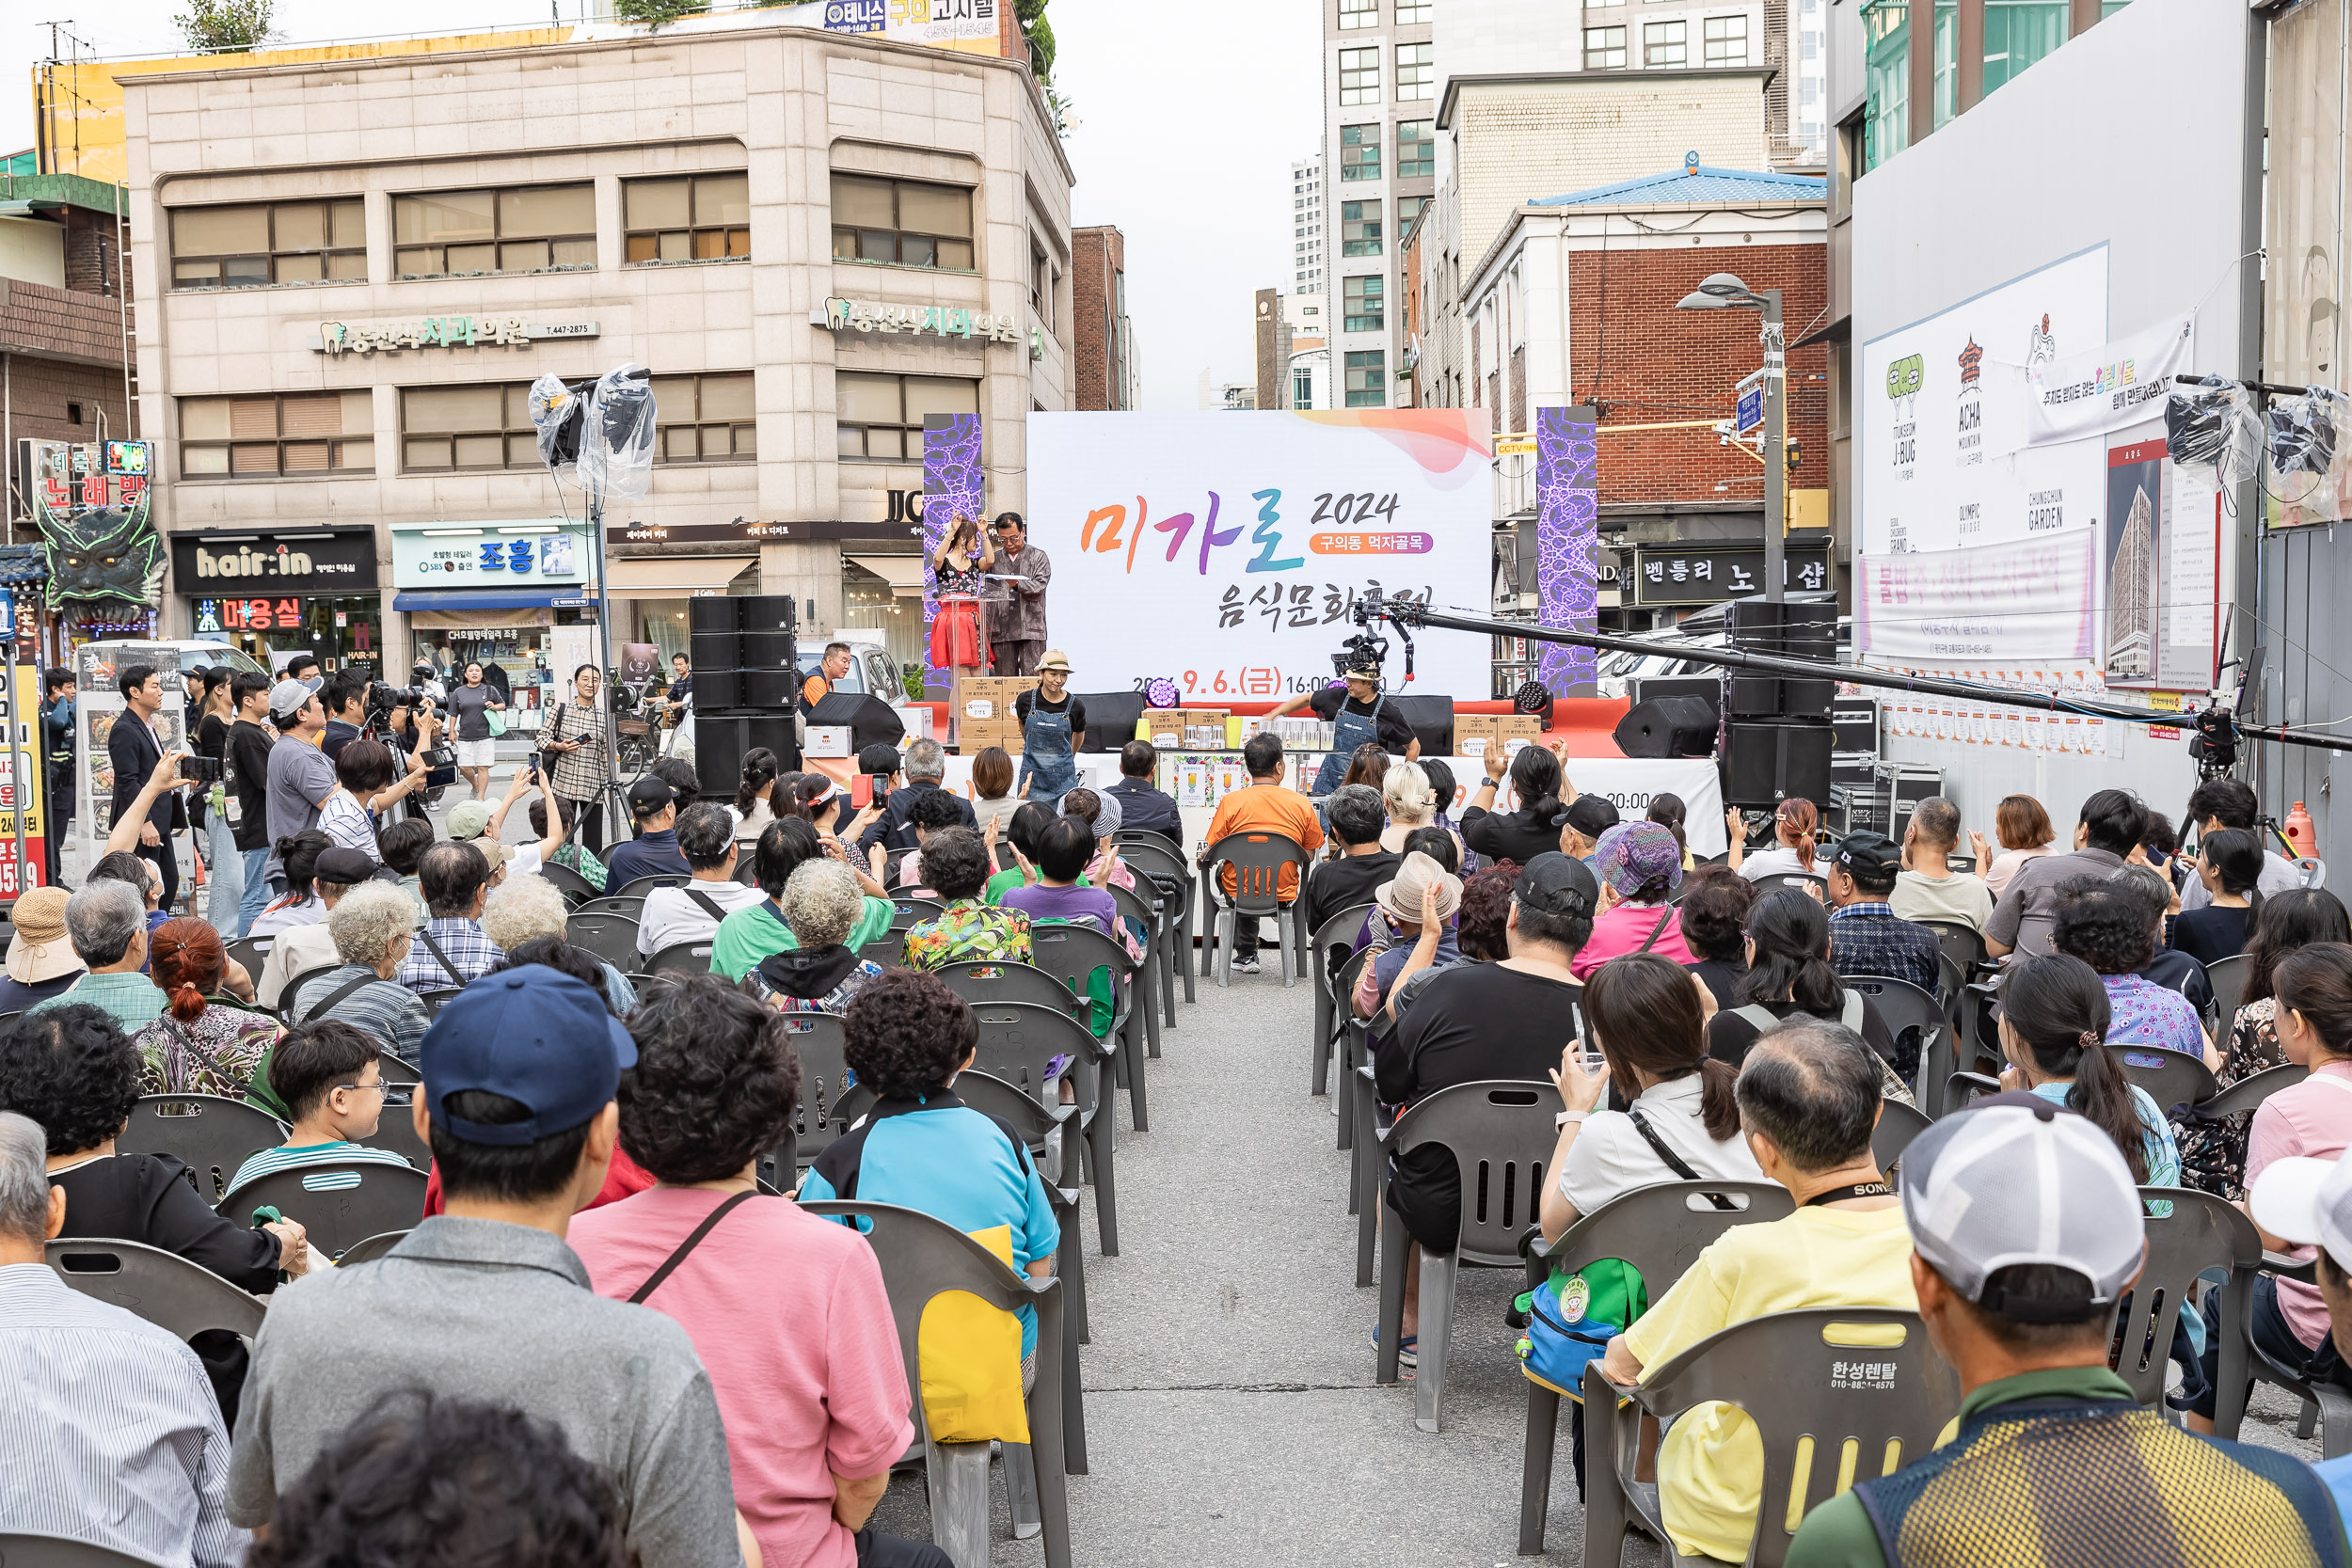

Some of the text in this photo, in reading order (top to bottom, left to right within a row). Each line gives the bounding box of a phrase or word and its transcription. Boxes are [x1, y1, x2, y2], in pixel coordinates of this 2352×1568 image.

[924, 22, 994, 39] 453-1545
[1959, 401, 1980, 433] ACHA
[1499, 445, 1522, 453] CCTV
[1959, 433, 1981, 451] MOUNTAIN
[1893, 438, 1915, 466] J-BUG
[47, 475, 147, 508] 노래방
[2029, 488, 2063, 506] CHUNGCHUN
[1311, 493, 1400, 526] 2024
[1960, 503, 1980, 521] OLYMPIC
[2028, 506, 2063, 531] GARDEN
[654, 529, 668, 539] 커피
[747, 527, 760, 536] 커피
[769, 526, 789, 535] 디저트
[1081, 488, 1306, 576] 미가로
[1960, 520, 1980, 533] BRIDGE
[1320, 533, 1423, 551] 구의동 먹자골목
[1890, 538, 1907, 554] GRAND
[433, 550, 472, 560] 호텔형 테일러
[479, 539, 534, 573] 조흥
[430, 562, 473, 572] SBS 출연
[1727, 562, 1825, 591] 노샵
[222, 598, 301, 630] 미용실
[347, 651, 378, 659] HAIR-IN
[1607, 793, 1649, 809] 20:00
[1853, 1183, 1889, 1196] SONY
[1832, 1361, 1898, 1380] 한성렌탈
